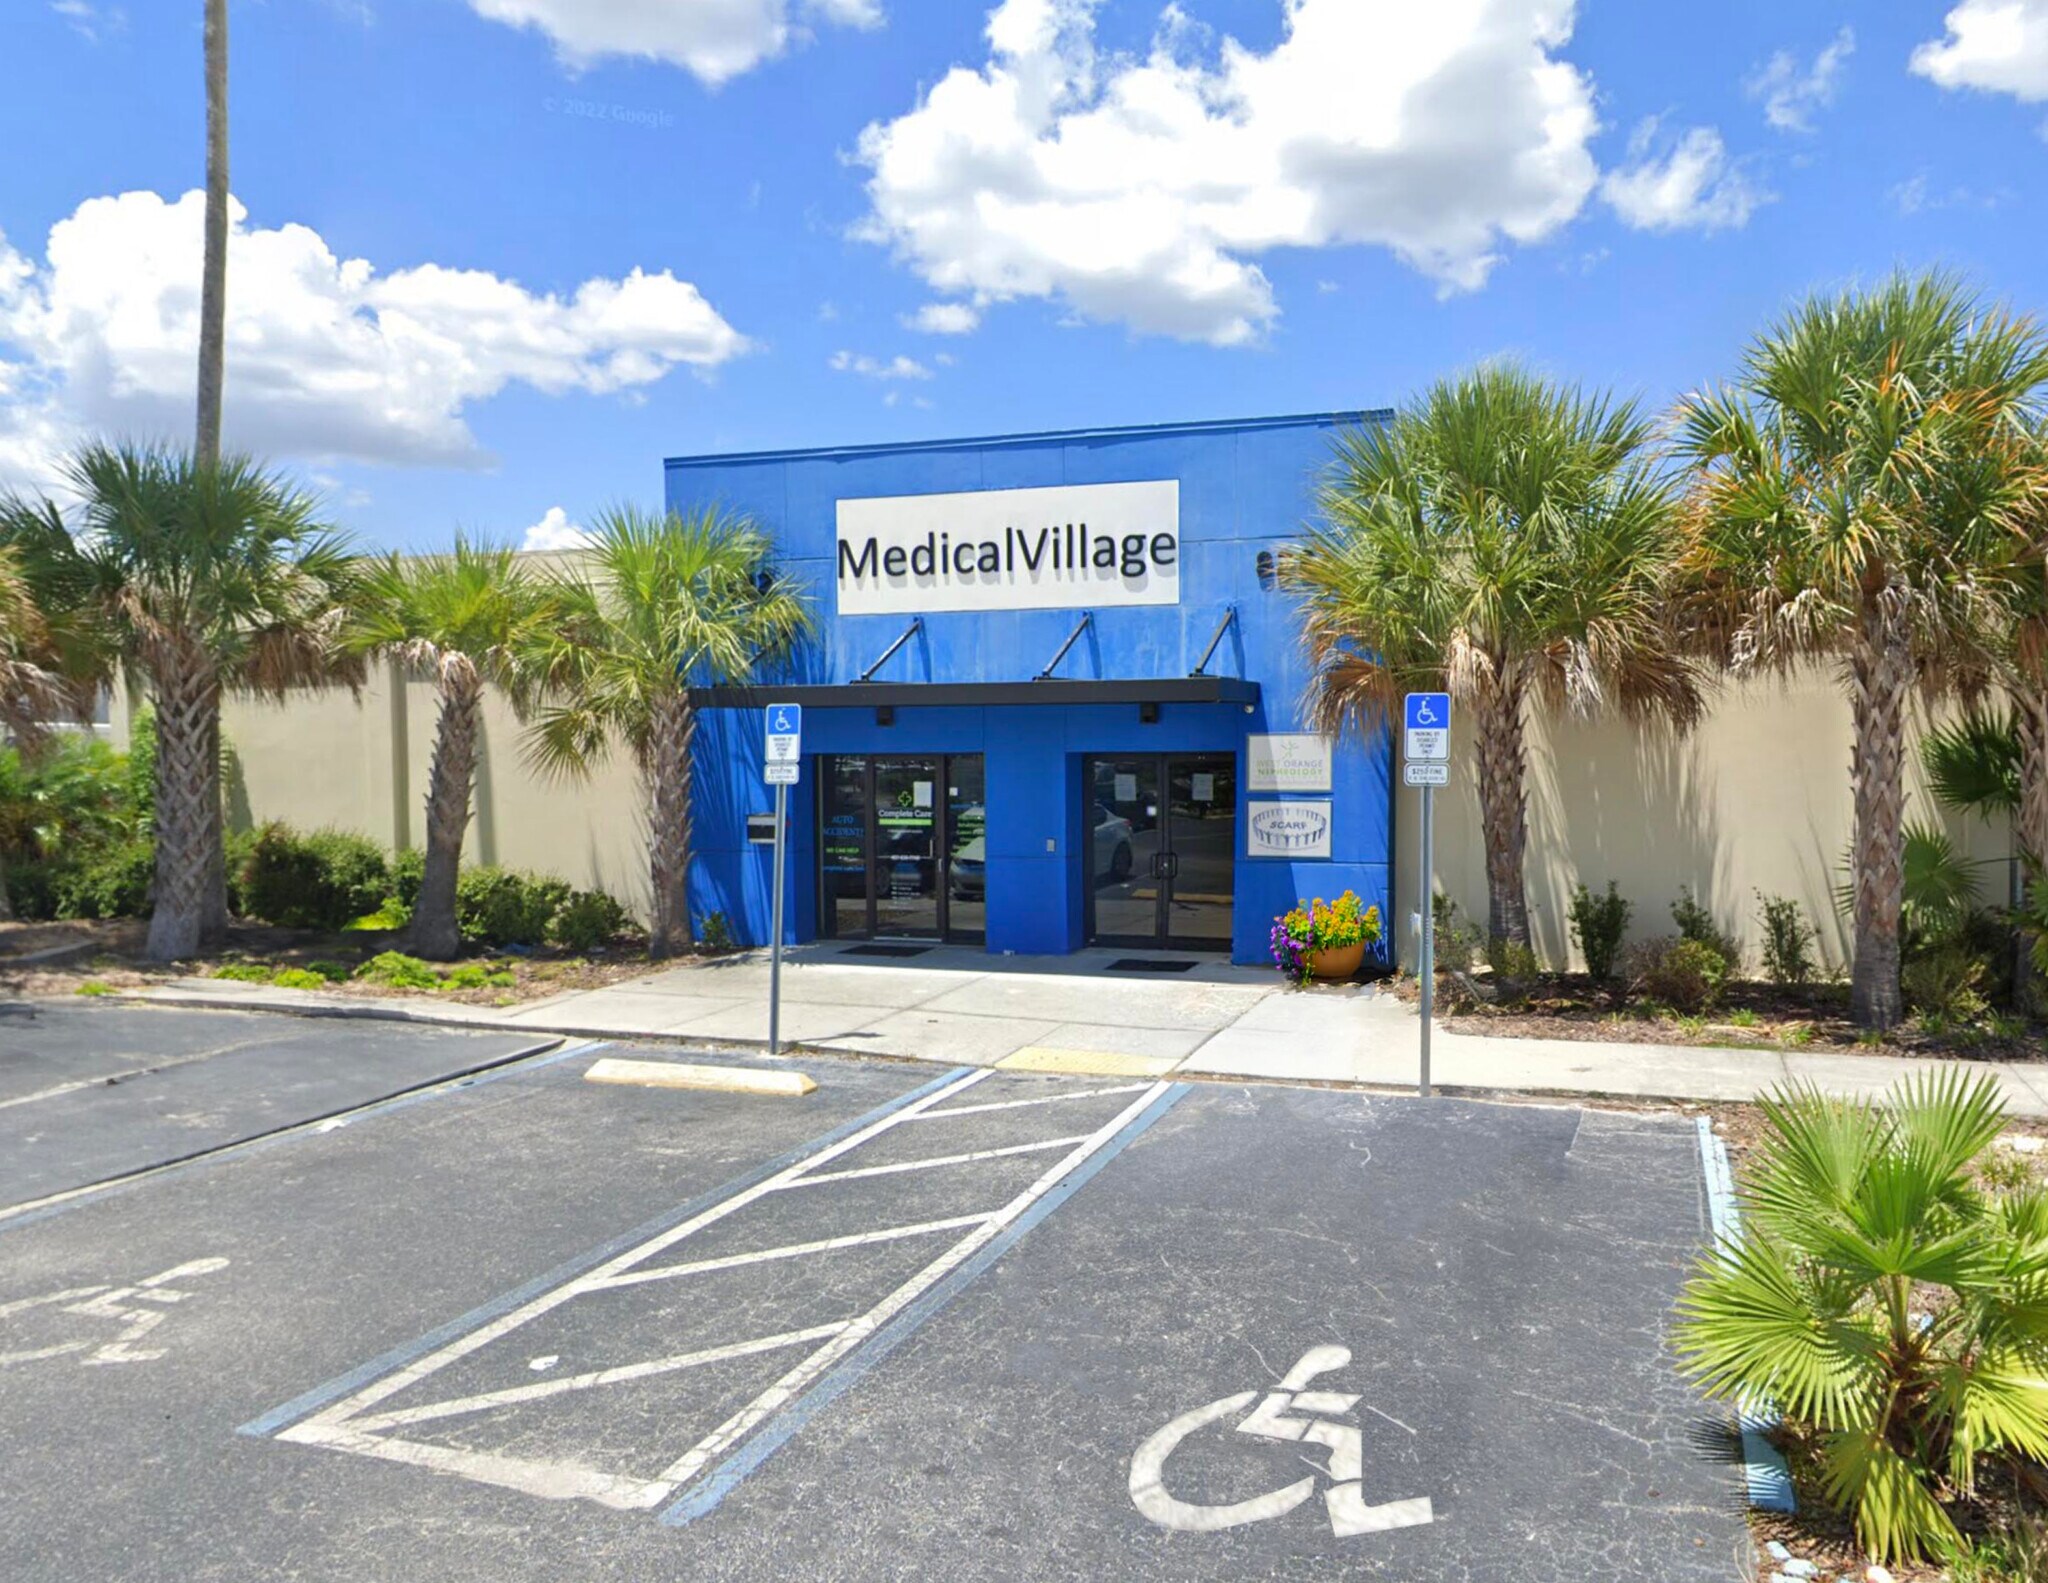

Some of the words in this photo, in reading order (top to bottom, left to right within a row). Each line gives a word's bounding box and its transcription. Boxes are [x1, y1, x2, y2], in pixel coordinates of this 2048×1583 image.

[1284, 759, 1323, 768] ORANGE
[1257, 768, 1323, 776] NEPHROLOGY
[878, 809, 913, 819] Complete
[914, 809, 933, 818] Care
[831, 815, 854, 824] AUTO
[1269, 821, 1307, 830] SCARF
